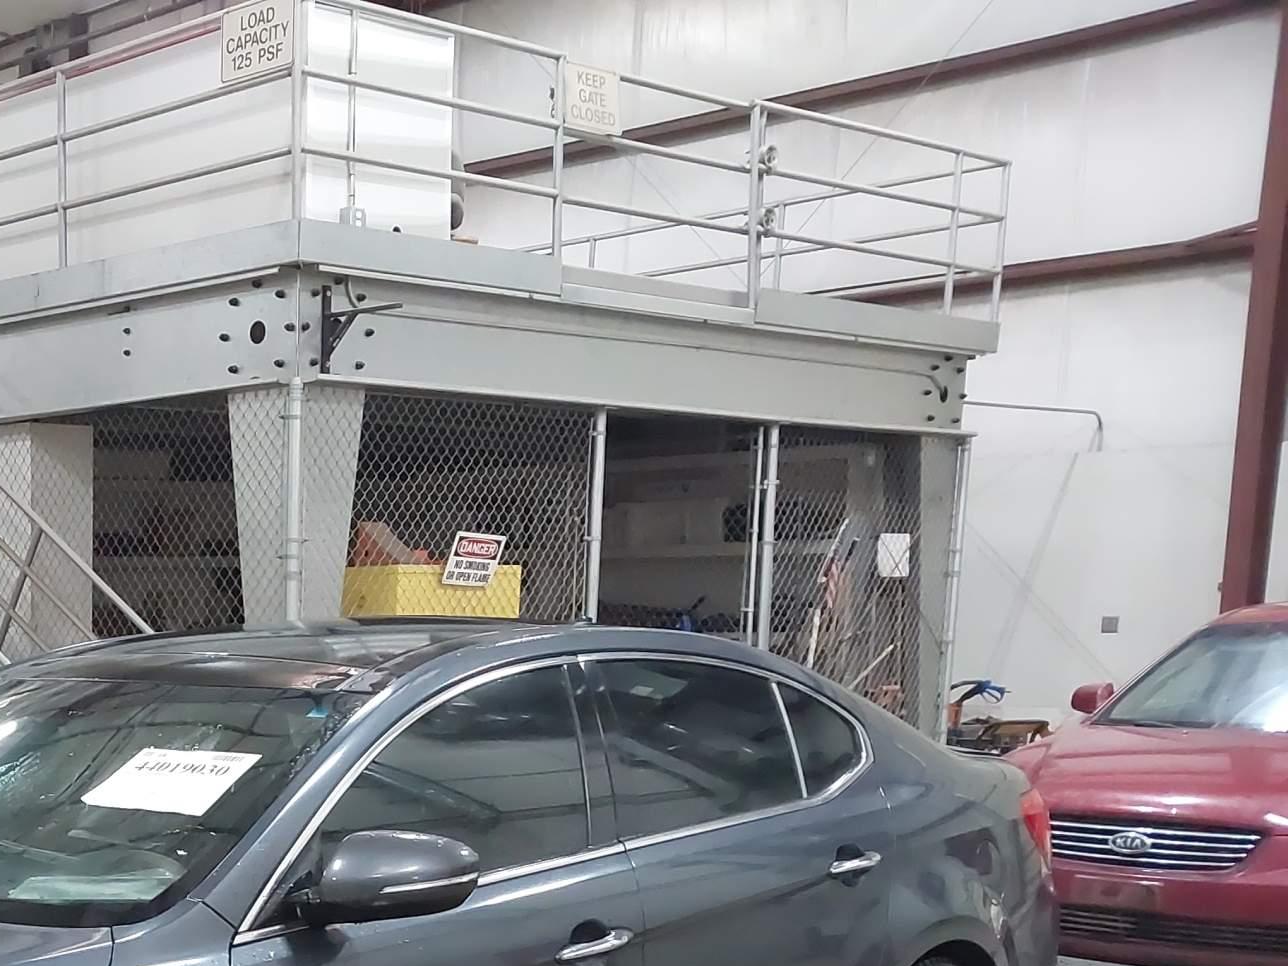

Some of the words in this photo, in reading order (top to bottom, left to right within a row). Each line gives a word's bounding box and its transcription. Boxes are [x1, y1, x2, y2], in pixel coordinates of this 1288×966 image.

[240, 7, 275, 31] LOAD
[226, 20, 289, 55] CAPACITY
[231, 51, 252, 71] 125
[258, 42, 283, 64] PSF
[577, 71, 606, 88] KEEP
[579, 88, 607, 107] GATE
[571, 104, 615, 126] CLOSED
[460, 541, 496, 555] DANGER
[135, 761, 230, 776] 44019030
[1115, 837, 1142, 849] KIA
